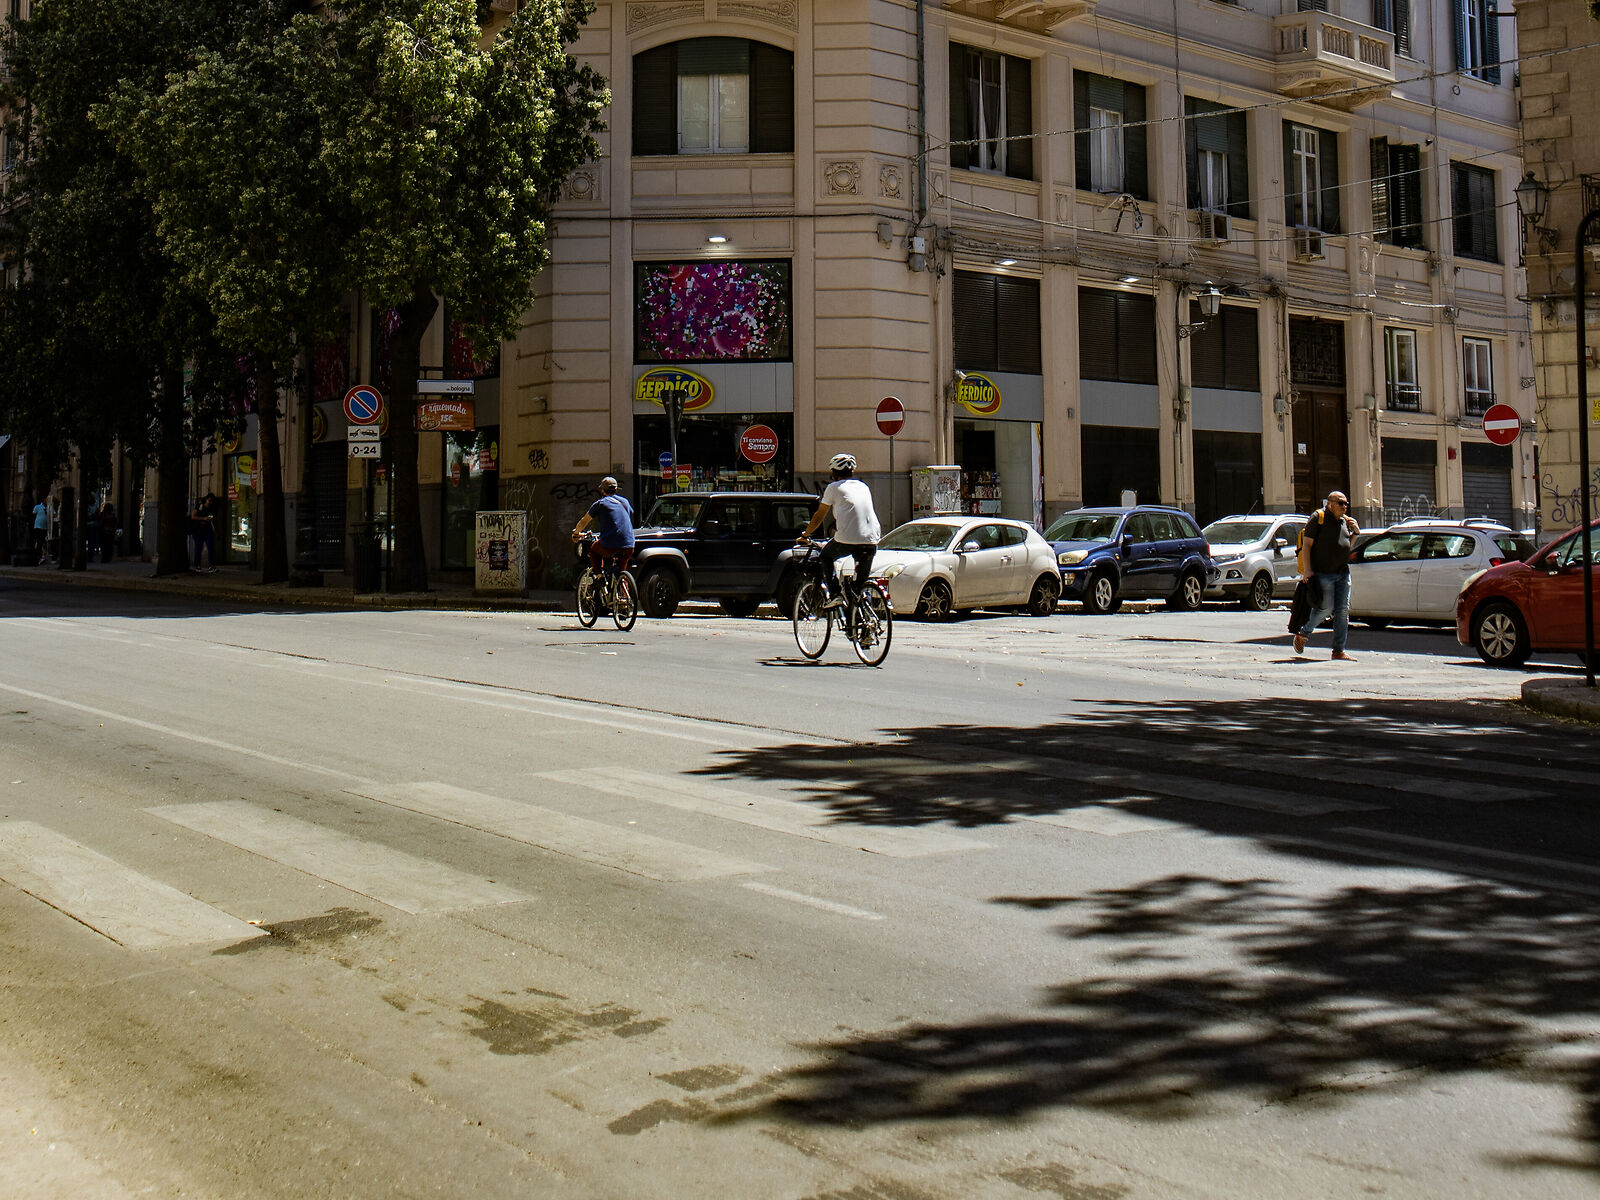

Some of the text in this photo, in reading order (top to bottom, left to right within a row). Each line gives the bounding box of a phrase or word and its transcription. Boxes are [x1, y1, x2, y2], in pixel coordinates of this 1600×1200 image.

[421, 403, 467, 415] Trquemada
[440, 414, 453, 422] 15€
[353, 446, 376, 454] 0-24
[748, 442, 775, 451] Sempre
